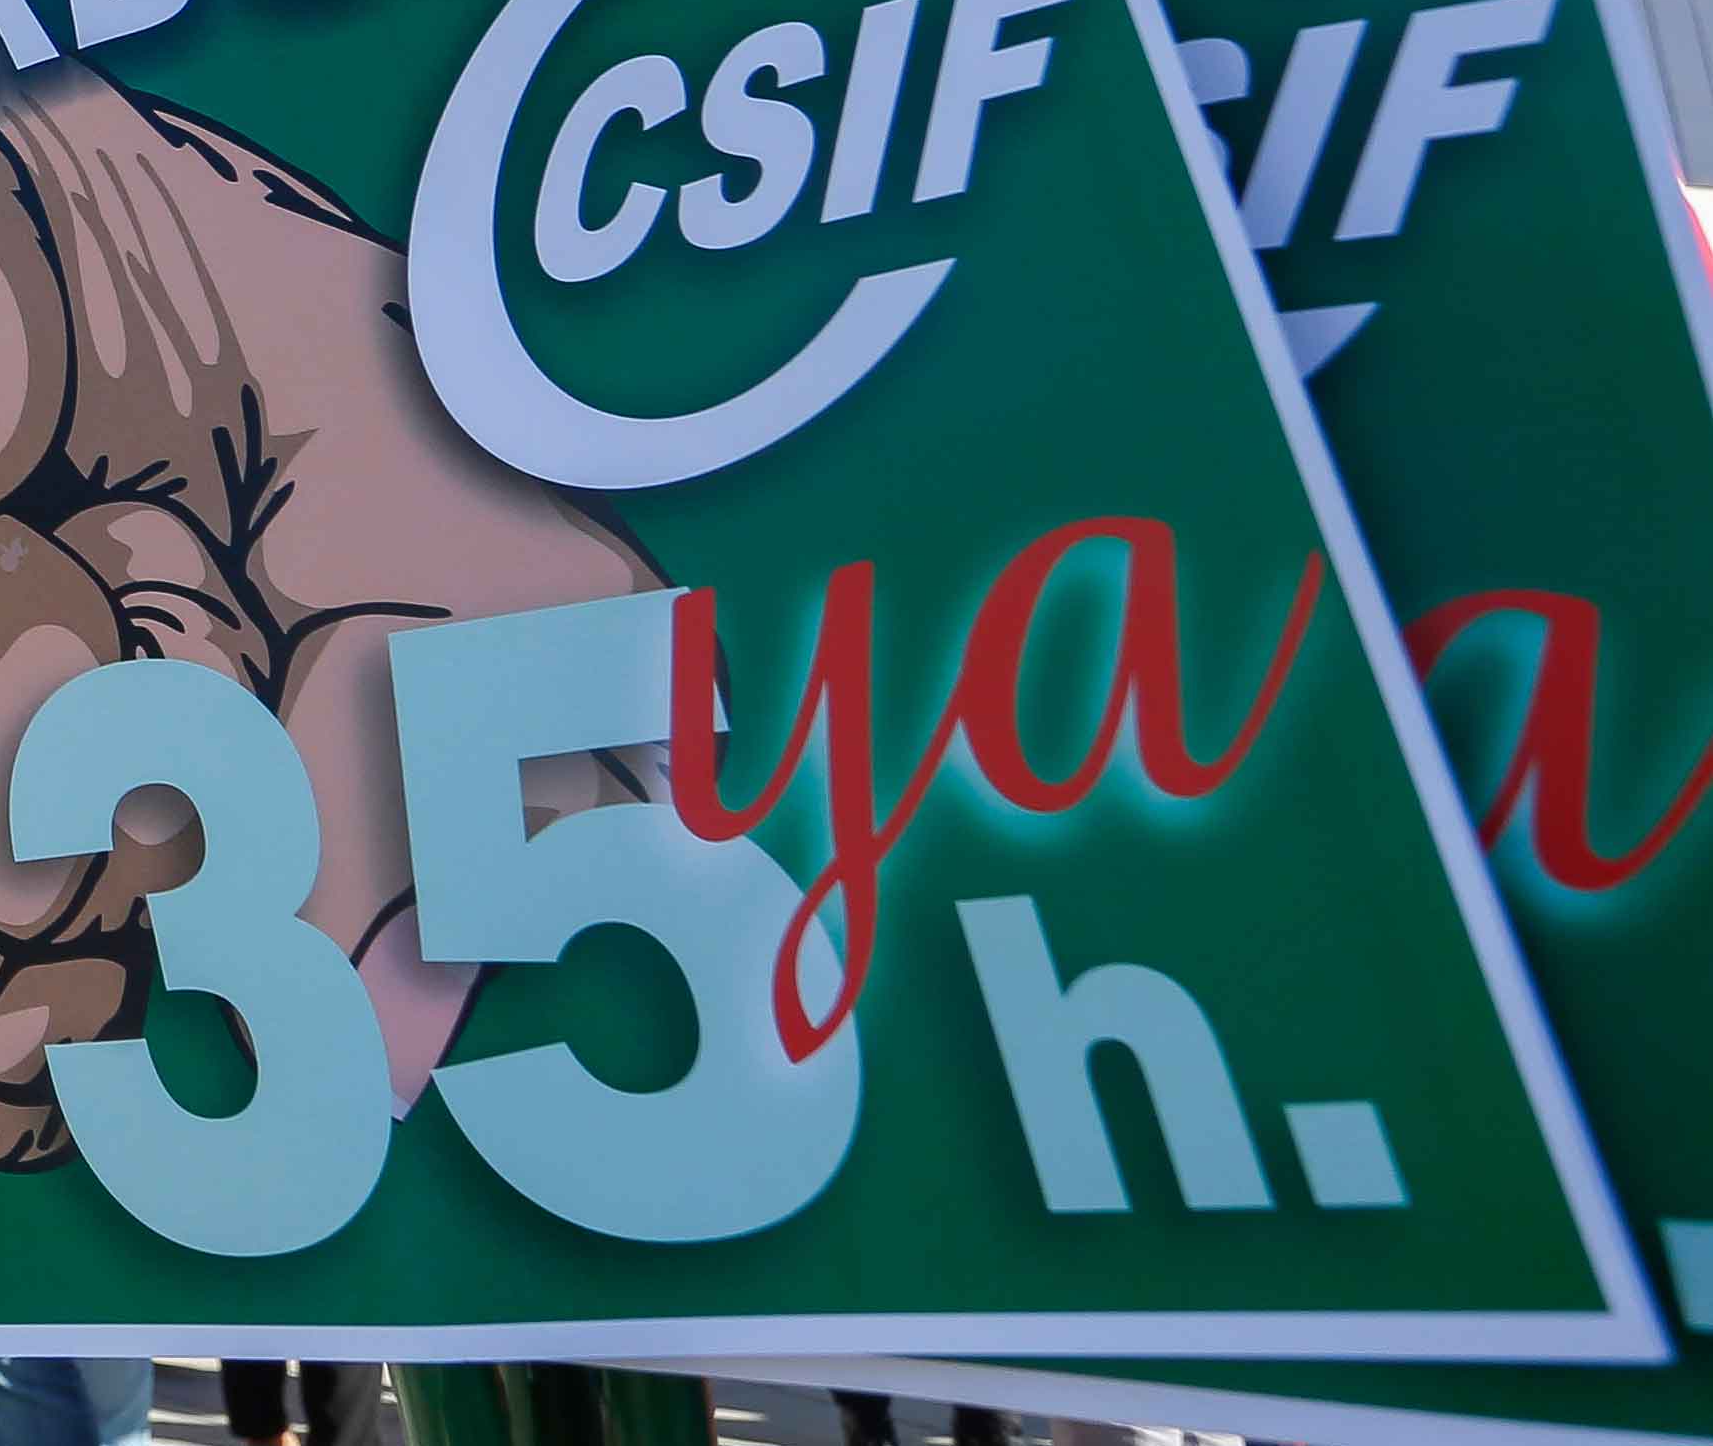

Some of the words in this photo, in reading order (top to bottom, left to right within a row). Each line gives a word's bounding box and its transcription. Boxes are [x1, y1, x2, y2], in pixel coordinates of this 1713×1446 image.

[9, 586, 862, 1258] 35
[955, 895, 1407, 1213] h.
[670, 516, 1323, 1062] ya
